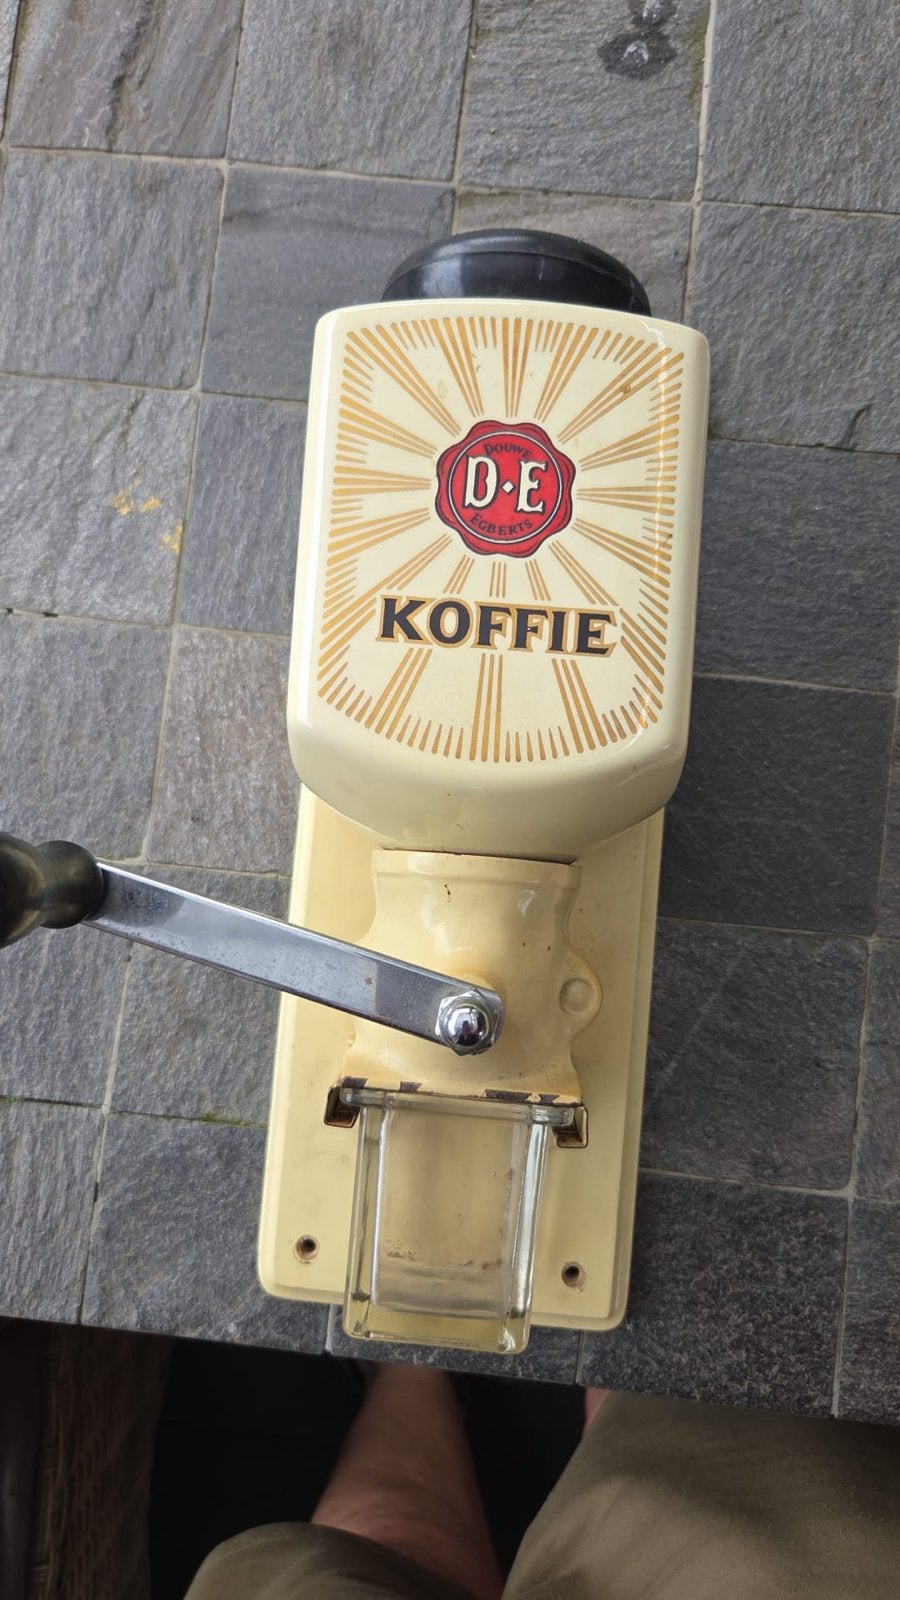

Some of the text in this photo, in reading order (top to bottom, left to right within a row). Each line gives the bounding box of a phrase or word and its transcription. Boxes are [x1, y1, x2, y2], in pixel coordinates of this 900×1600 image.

[484, 442, 533, 460] DOUWE
[470, 513, 533, 536] EGBERTS
[376, 594, 617, 657] KOFFIE
